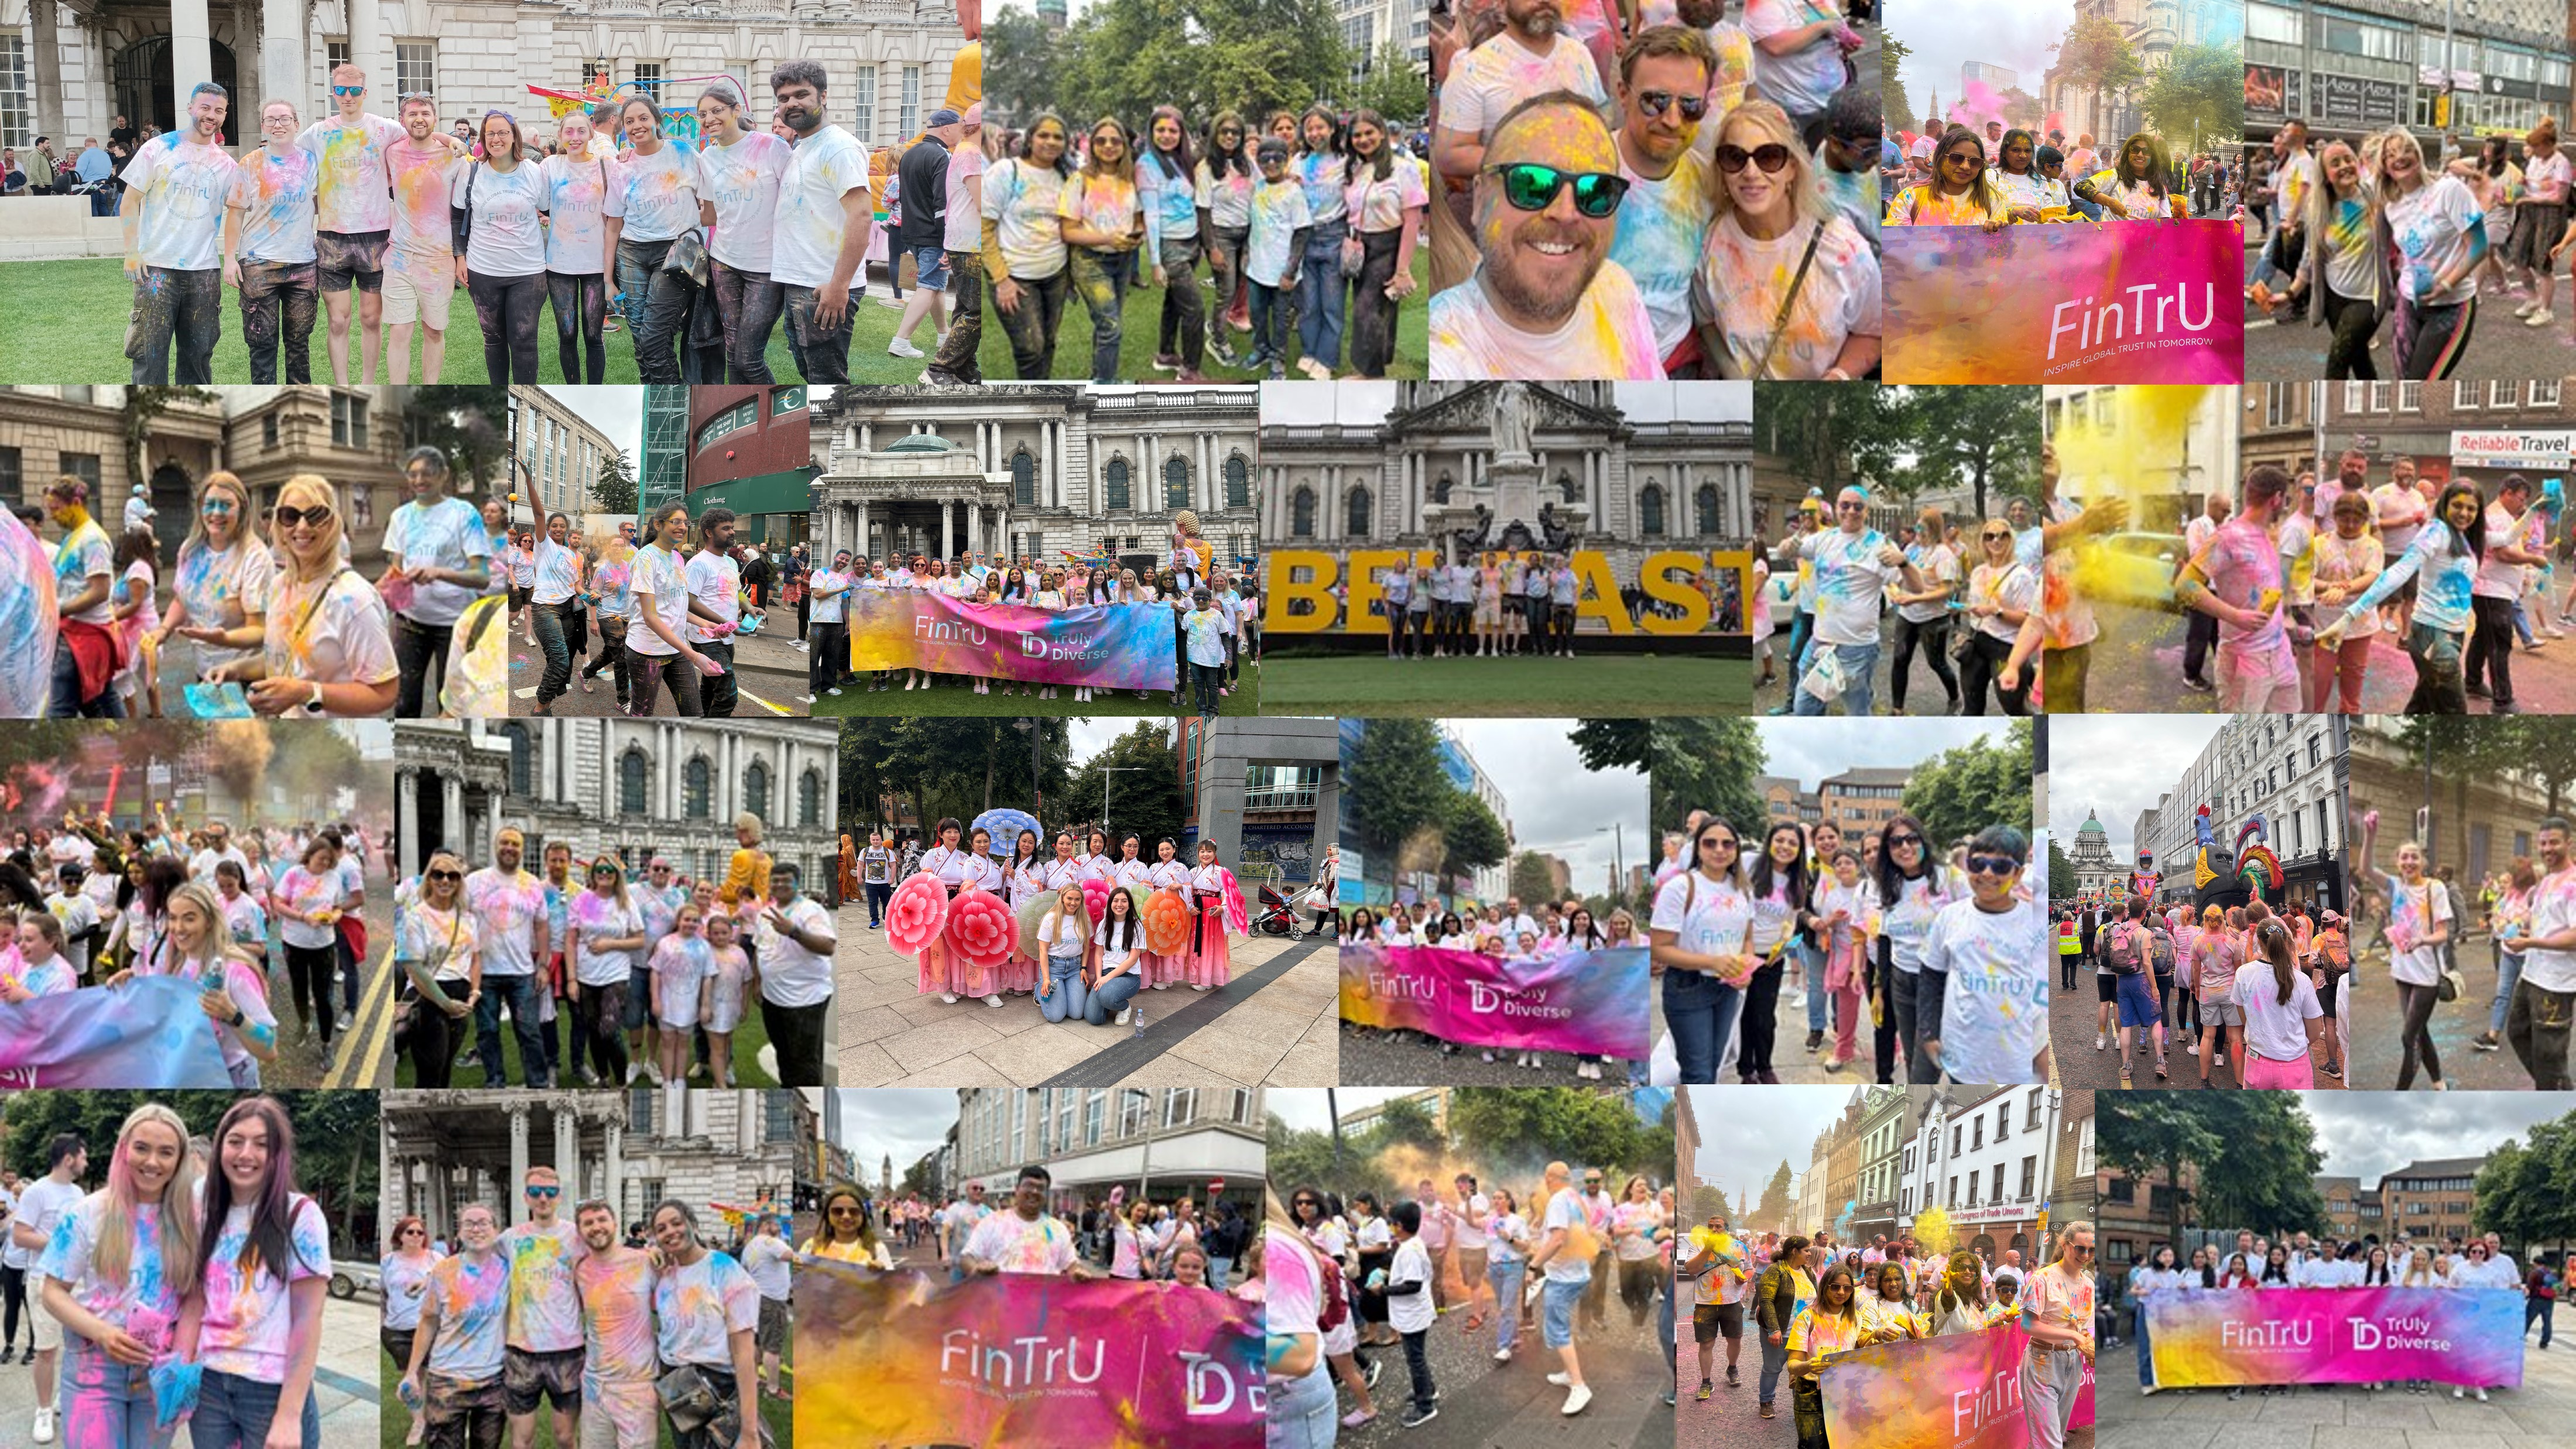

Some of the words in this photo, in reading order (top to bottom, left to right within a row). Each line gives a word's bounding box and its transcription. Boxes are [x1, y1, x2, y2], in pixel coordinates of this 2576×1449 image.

[487, 191, 502, 201] GLOBAL
[635, 192, 678, 211] FinTrU
[715, 189, 753, 203] FinTrU
[557, 198, 597, 213] FinTrU
[488, 212, 528, 222] FinTrU
[2047, 282, 2214, 360] FinTrU
[2043, 358, 2081, 376] INSPIRE
[2083, 348, 2116, 364] GLOBAL
[2118, 342, 2145, 353] TRUST
[2147, 340, 2156, 349] IN
[2158, 338, 2214, 348] TOMORROW
[742, 409, 753, 417] WIFI
[743, 402, 754, 410] FREE
[715, 415, 724, 424] YOU
[723, 410, 734, 420] SHOP
[722, 419, 732, 428] SHIP
[704, 496, 726, 505] Clothing
[915, 615, 987, 645] FinTrU
[964, 643, 986, 652] TOMORROW
[1054, 632, 1092, 648] TrUly
[1053, 648, 1109, 660] Diverse
[1308, 899, 1328, 909] Iceland
[1369, 971, 1436, 999] FinTrU
[1503, 1001, 1572, 1019] Diverse
[1049, 1077, 1067, 1088] The
[1066, 1065, 1088, 1081] school
[1949, 1212, 1959, 1221] Irish
[1959, 1210, 1979, 1221] Congress
[1986, 1207, 2000, 1217] Trade
[2002, 1206, 2024, 1216] Unions
[2386, 1317, 2430, 1334] TrUly
[2222, 1320, 2313, 1347] FinTrU
[2386, 1336, 2451, 1352] Diverse
[941, 1330, 1105, 1386] FinTrU
[1954, 1437, 1975, 1449] INSPIRE
[1988, 1416, 2003, 1427] TRUST
